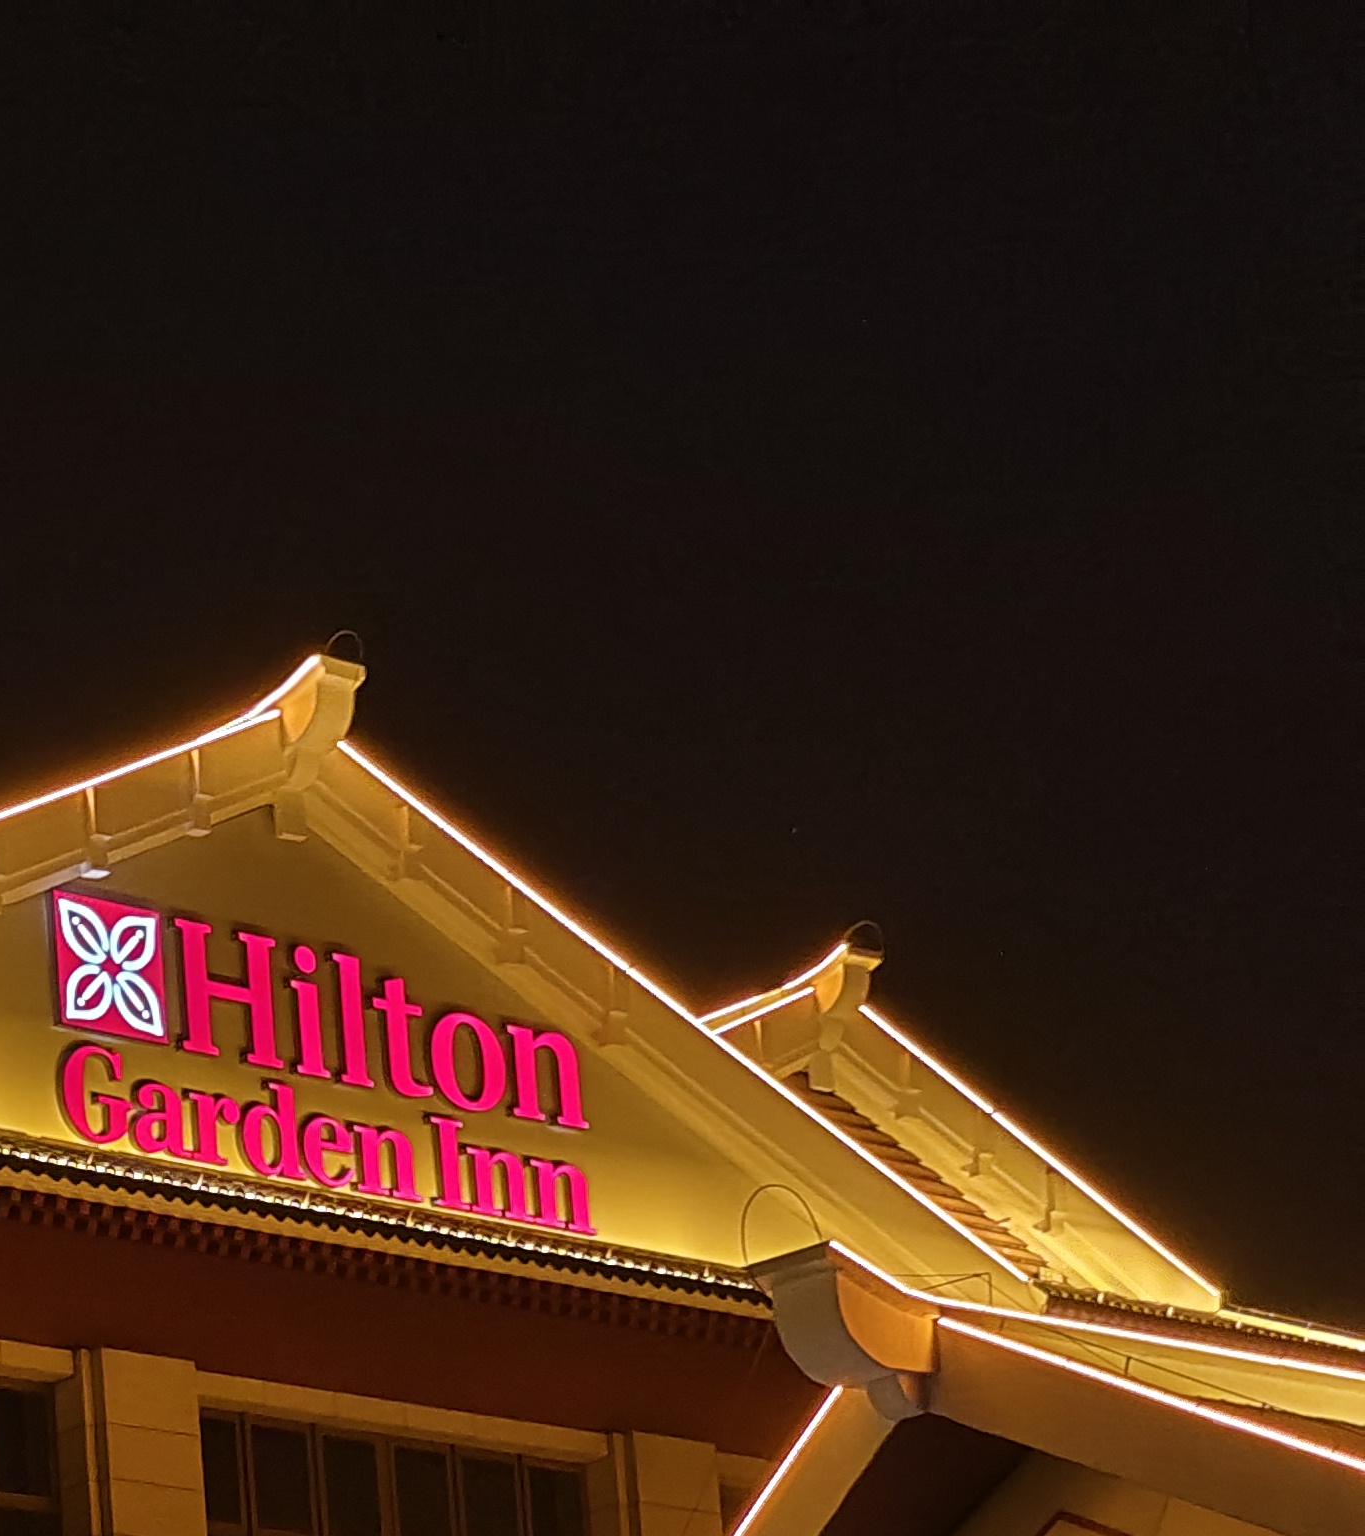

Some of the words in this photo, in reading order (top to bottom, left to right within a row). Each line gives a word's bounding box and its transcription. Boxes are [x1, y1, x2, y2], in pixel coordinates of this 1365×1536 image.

[174, 917, 589, 1129] Hilton
[62, 1045, 423, 1201] Garden
[430, 1115, 597, 1235] Inn
